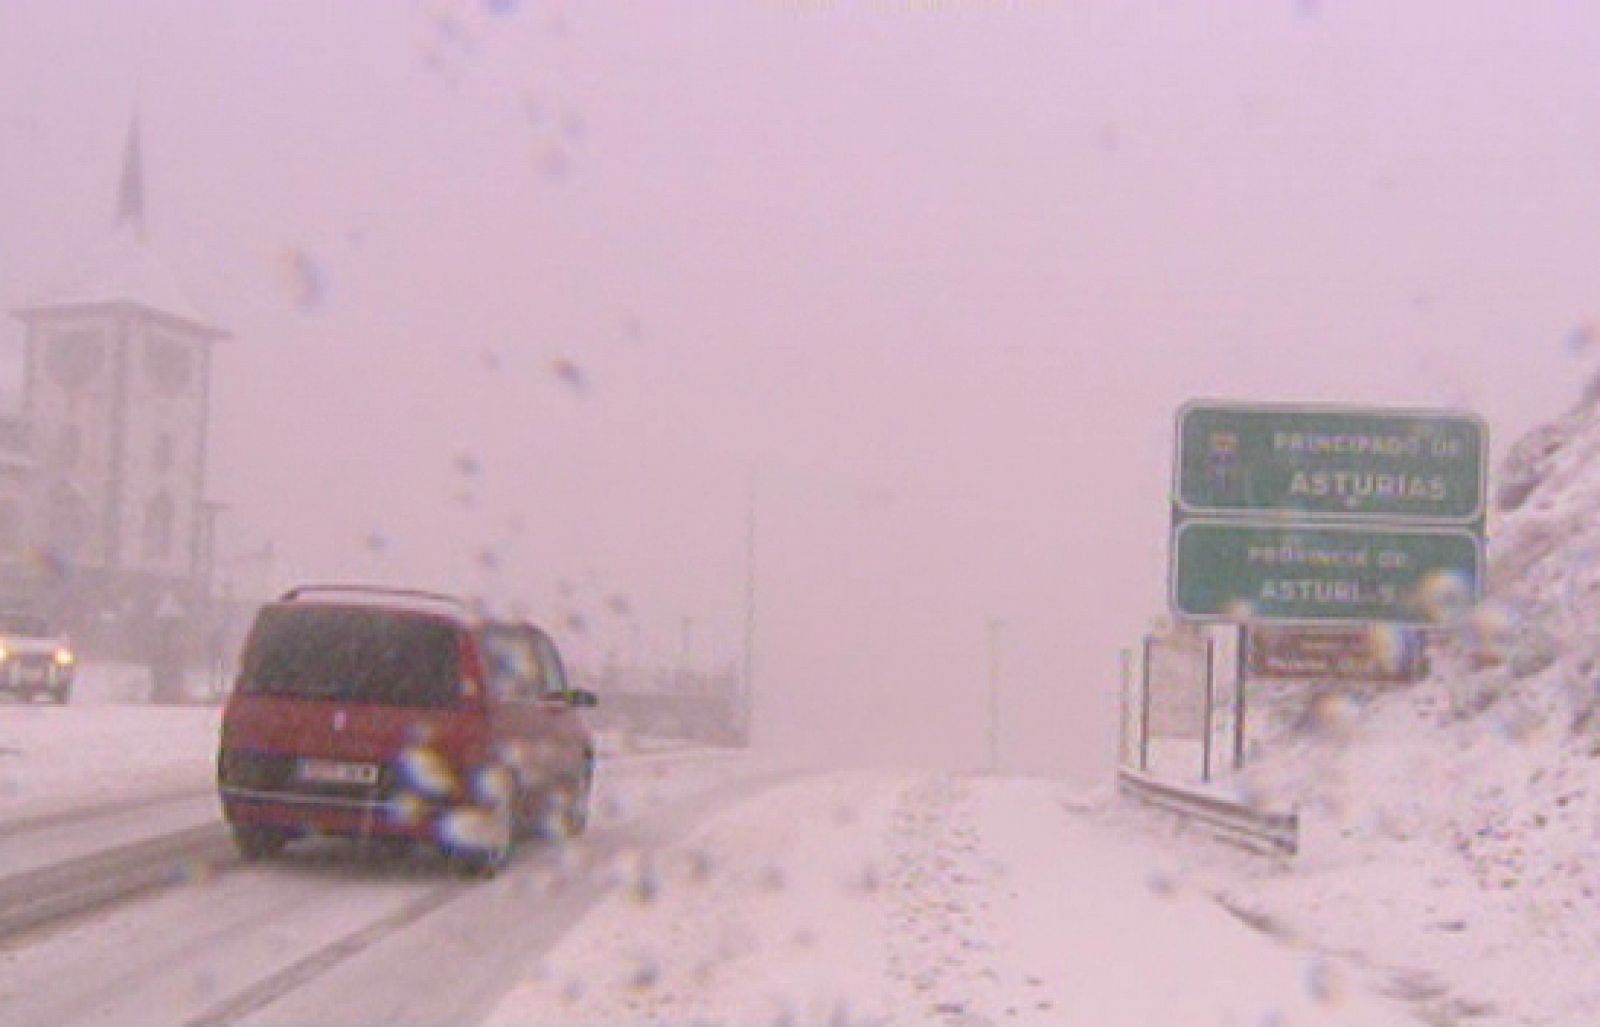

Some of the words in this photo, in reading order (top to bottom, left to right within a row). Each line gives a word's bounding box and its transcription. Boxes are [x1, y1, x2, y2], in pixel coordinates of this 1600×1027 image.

[1273, 432, 1420, 455] PRINCIPADO
[1289, 470, 1447, 500] ASTURIAS
[1261, 578, 1399, 603] ASTURIS
